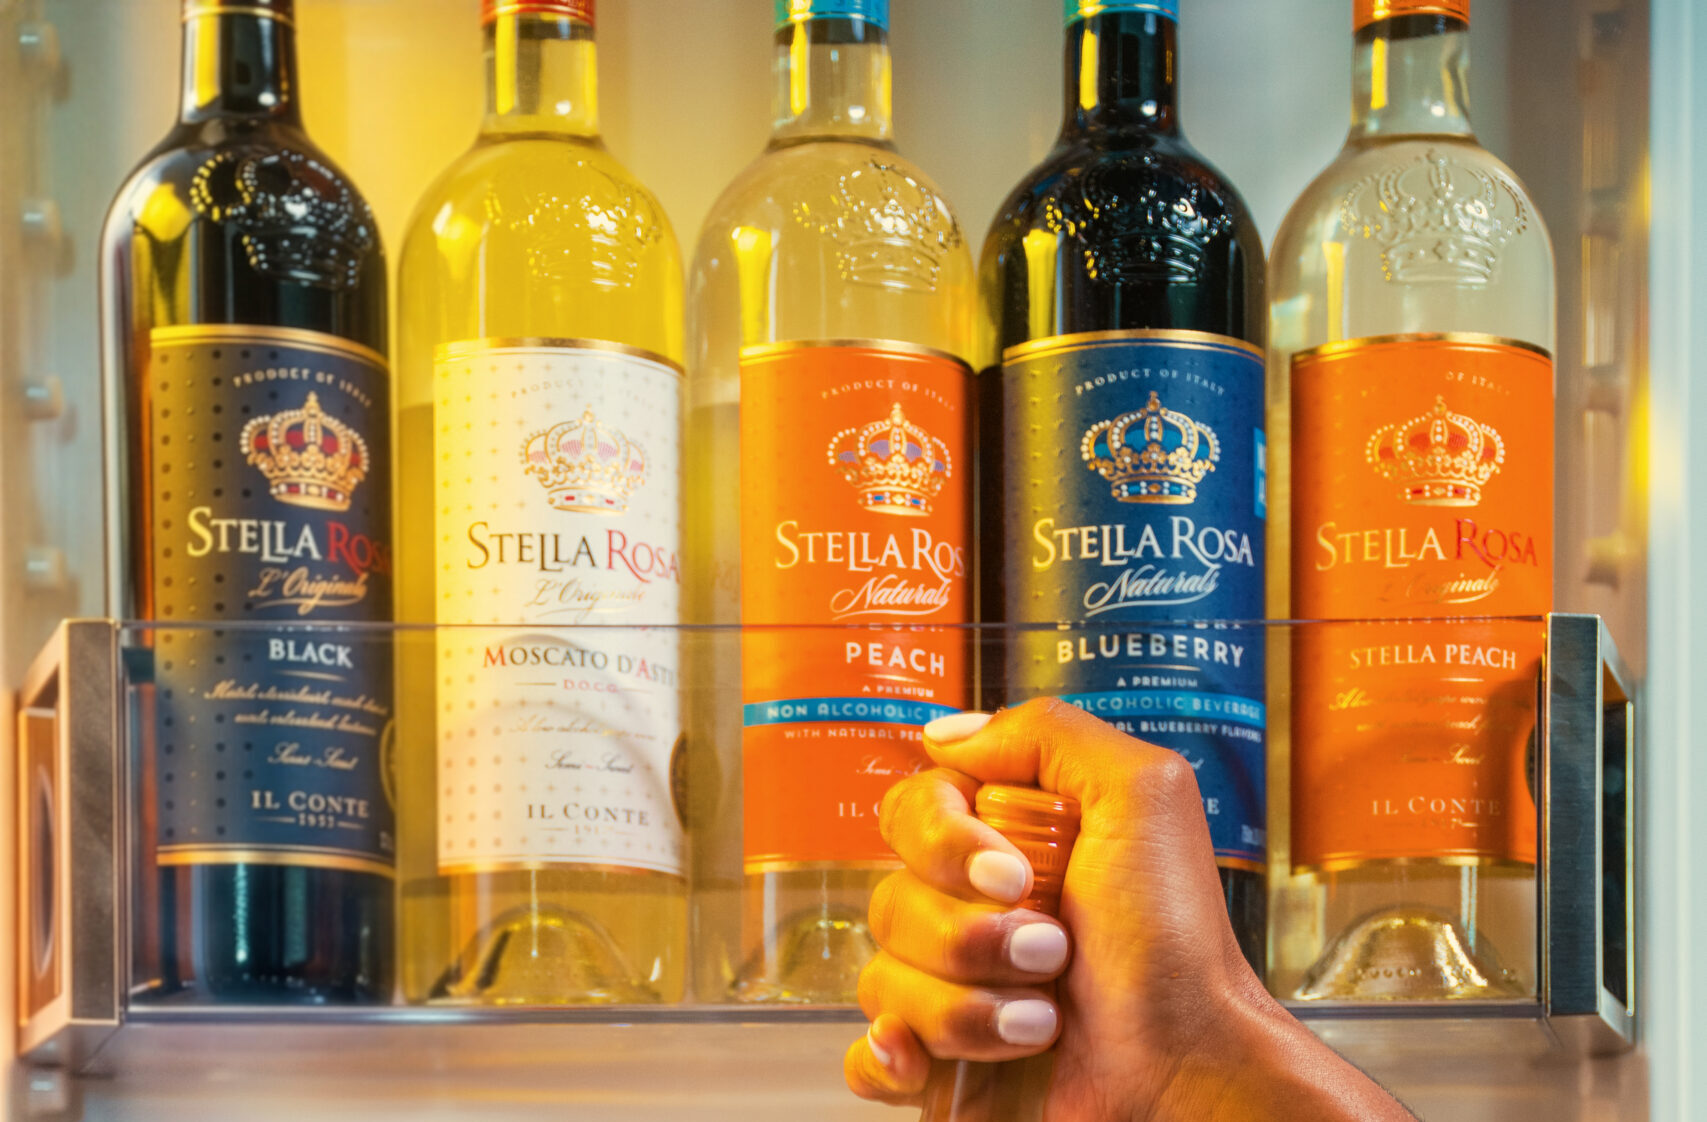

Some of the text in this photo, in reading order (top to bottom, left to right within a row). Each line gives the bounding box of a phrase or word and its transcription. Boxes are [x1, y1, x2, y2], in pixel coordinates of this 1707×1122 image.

[233, 367, 310, 388] PRODUCT
[821, 379, 894, 400] PRODUCT
[902, 380, 919, 393] OF
[1075, 368, 1225, 395] PRODUCT OF ITALY
[187, 506, 323, 563] STELLA
[775, 520, 907, 572] STELLA
[1032, 515, 1255, 569] STELLA ROSA
[1316, 518, 1539, 571] STELLA ROSA
[467, 521, 681, 584] STELLA ROSA
[829, 573, 952, 617] Naturals
[1084, 563, 1221, 617] Naturals
[268, 638, 353, 668] BLACK
[483, 645, 608, 670] MOSCATO
[845, 642, 945, 677] PEACH
[1057, 633, 1245, 667] BLUEBERRY
[1350, 644, 1517, 670] STELLA PEACH
[862, 684, 934, 698] A PREMIUM
[1116, 676, 1198, 688] A PREMIUM
[767, 704, 808, 719] NON
[817, 702, 923, 720] ALCOHOLIC
[1193, 696, 1261, 720] BEVERAGE
[784, 729, 820, 739] WITH
[828, 728, 895, 740] NATURAL
[1140, 720, 1219, 735] BLUEBERRY
[251, 790, 369, 818] IL CONTE
[528, 802, 650, 827] IL CONTE
[838, 802, 865, 818] IL
[1373, 796, 1500, 816] IL CONTE
